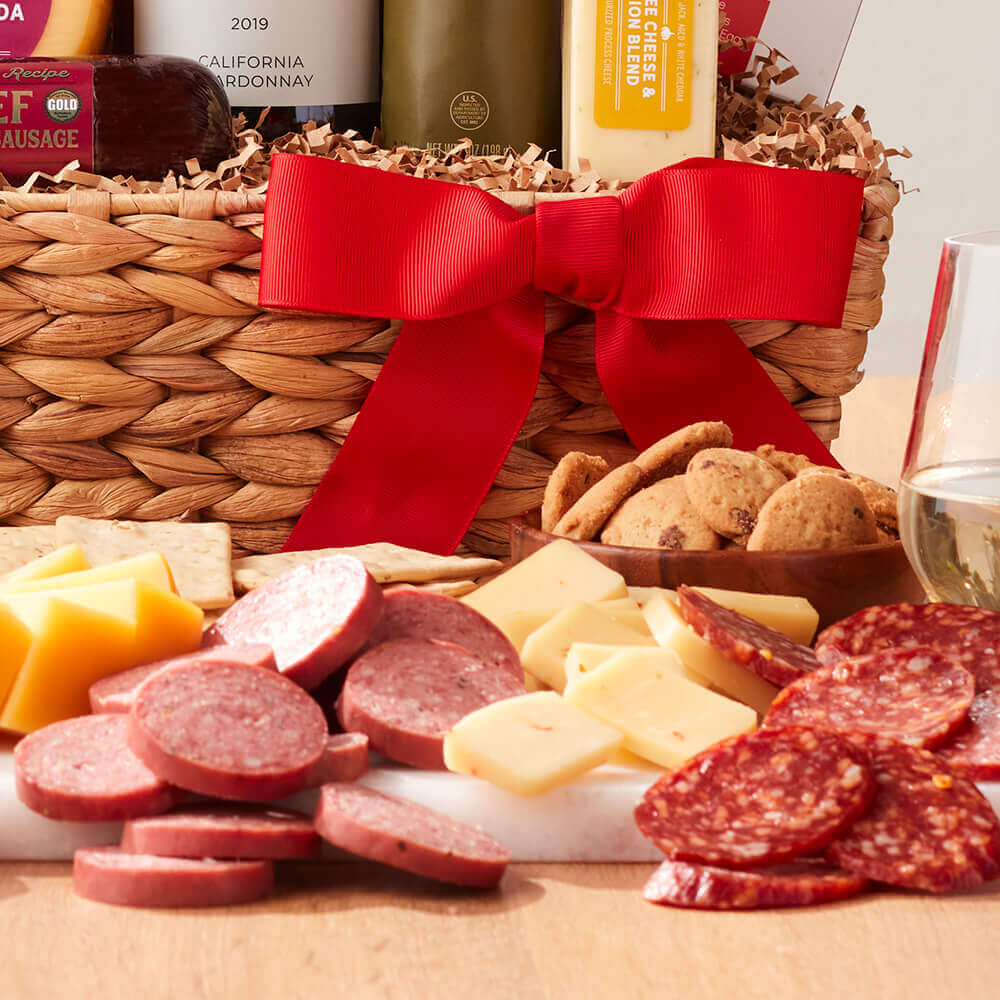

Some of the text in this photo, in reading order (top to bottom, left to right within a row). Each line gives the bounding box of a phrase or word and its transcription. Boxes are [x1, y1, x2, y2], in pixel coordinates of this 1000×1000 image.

[231, 17, 269, 31] 2019
[642, 21, 658, 82] CHEESE
[198, 54, 305, 69] CALIFORNIA
[626, 34, 641, 86] BLEND
[2, 67, 70, 82] Recipe
[642, 87, 656, 98] &
[47, 98, 78, 111] GOLD
